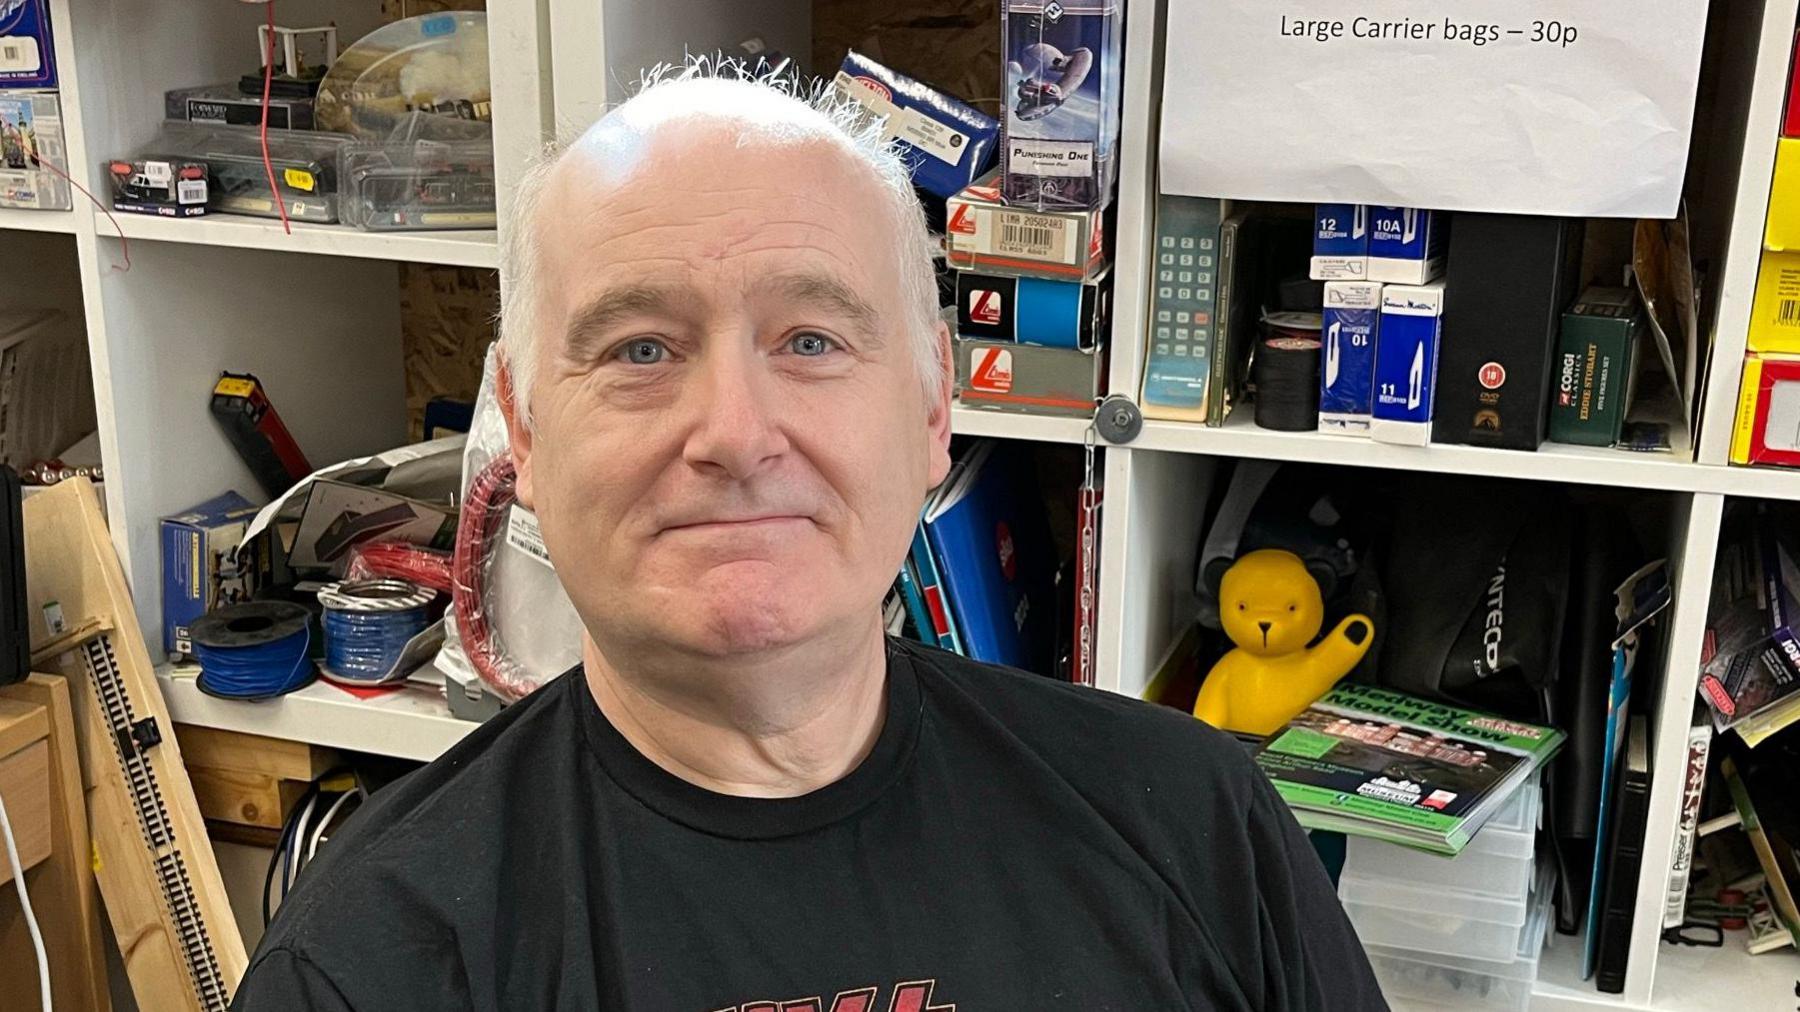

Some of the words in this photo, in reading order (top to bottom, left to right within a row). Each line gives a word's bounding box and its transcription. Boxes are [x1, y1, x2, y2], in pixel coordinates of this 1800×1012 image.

[1281, 15, 1344, 41] Large
[1352, 16, 1436, 40] Carrier
[1443, 18, 1500, 45] bags
[1531, 20, 1579, 47] 30p
[1320, 218, 1336, 231] 12
[1376, 219, 1401, 233] 10A
[1352, 334, 1368, 346] 10
[1381, 383, 1395, 395] 11
[1561, 353, 1575, 392] CORGI
[1571, 354, 1582, 407] CLASSICS
[1580, 389, 1592, 420] EDDIE
[1586, 343, 1597, 388] STOBART
[1327, 694, 1421, 720] Model
[1421, 715, 1510, 742] Show
[1339, 683, 1469, 720] Medway
[1672, 834, 1688, 870] Preiser
